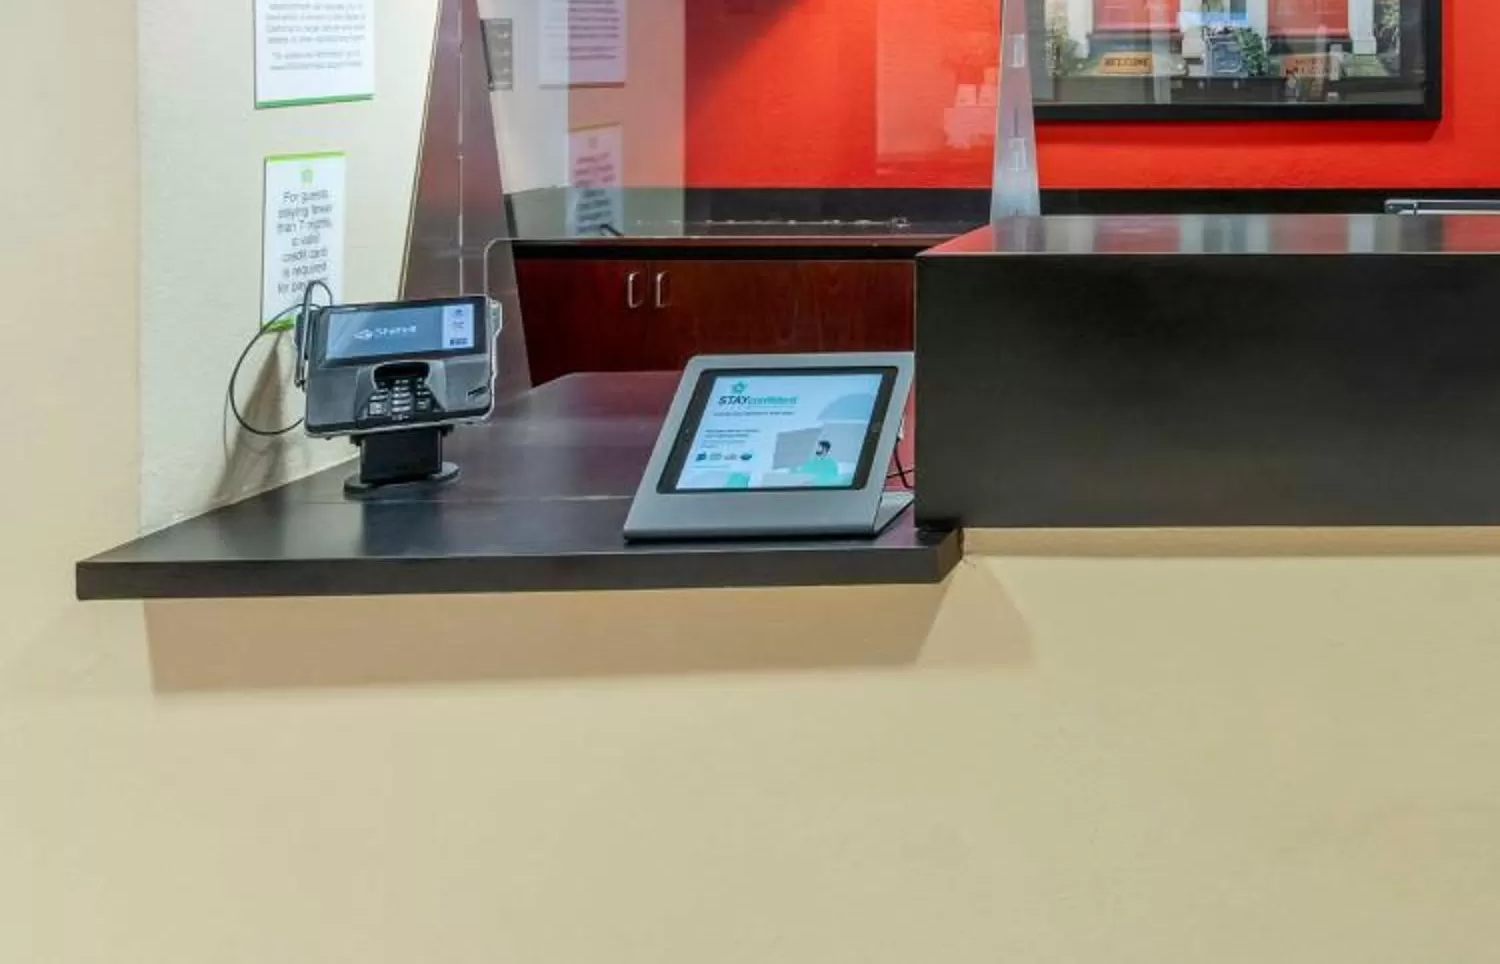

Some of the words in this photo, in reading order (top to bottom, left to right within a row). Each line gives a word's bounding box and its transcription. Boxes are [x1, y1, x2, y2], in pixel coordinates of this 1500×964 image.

[284, 190, 298, 203] For
[302, 190, 328, 204] guests
[277, 223, 296, 233] than
[283, 250, 306, 262] credit
[309, 248, 328, 259] card
[293, 262, 326, 276] required
